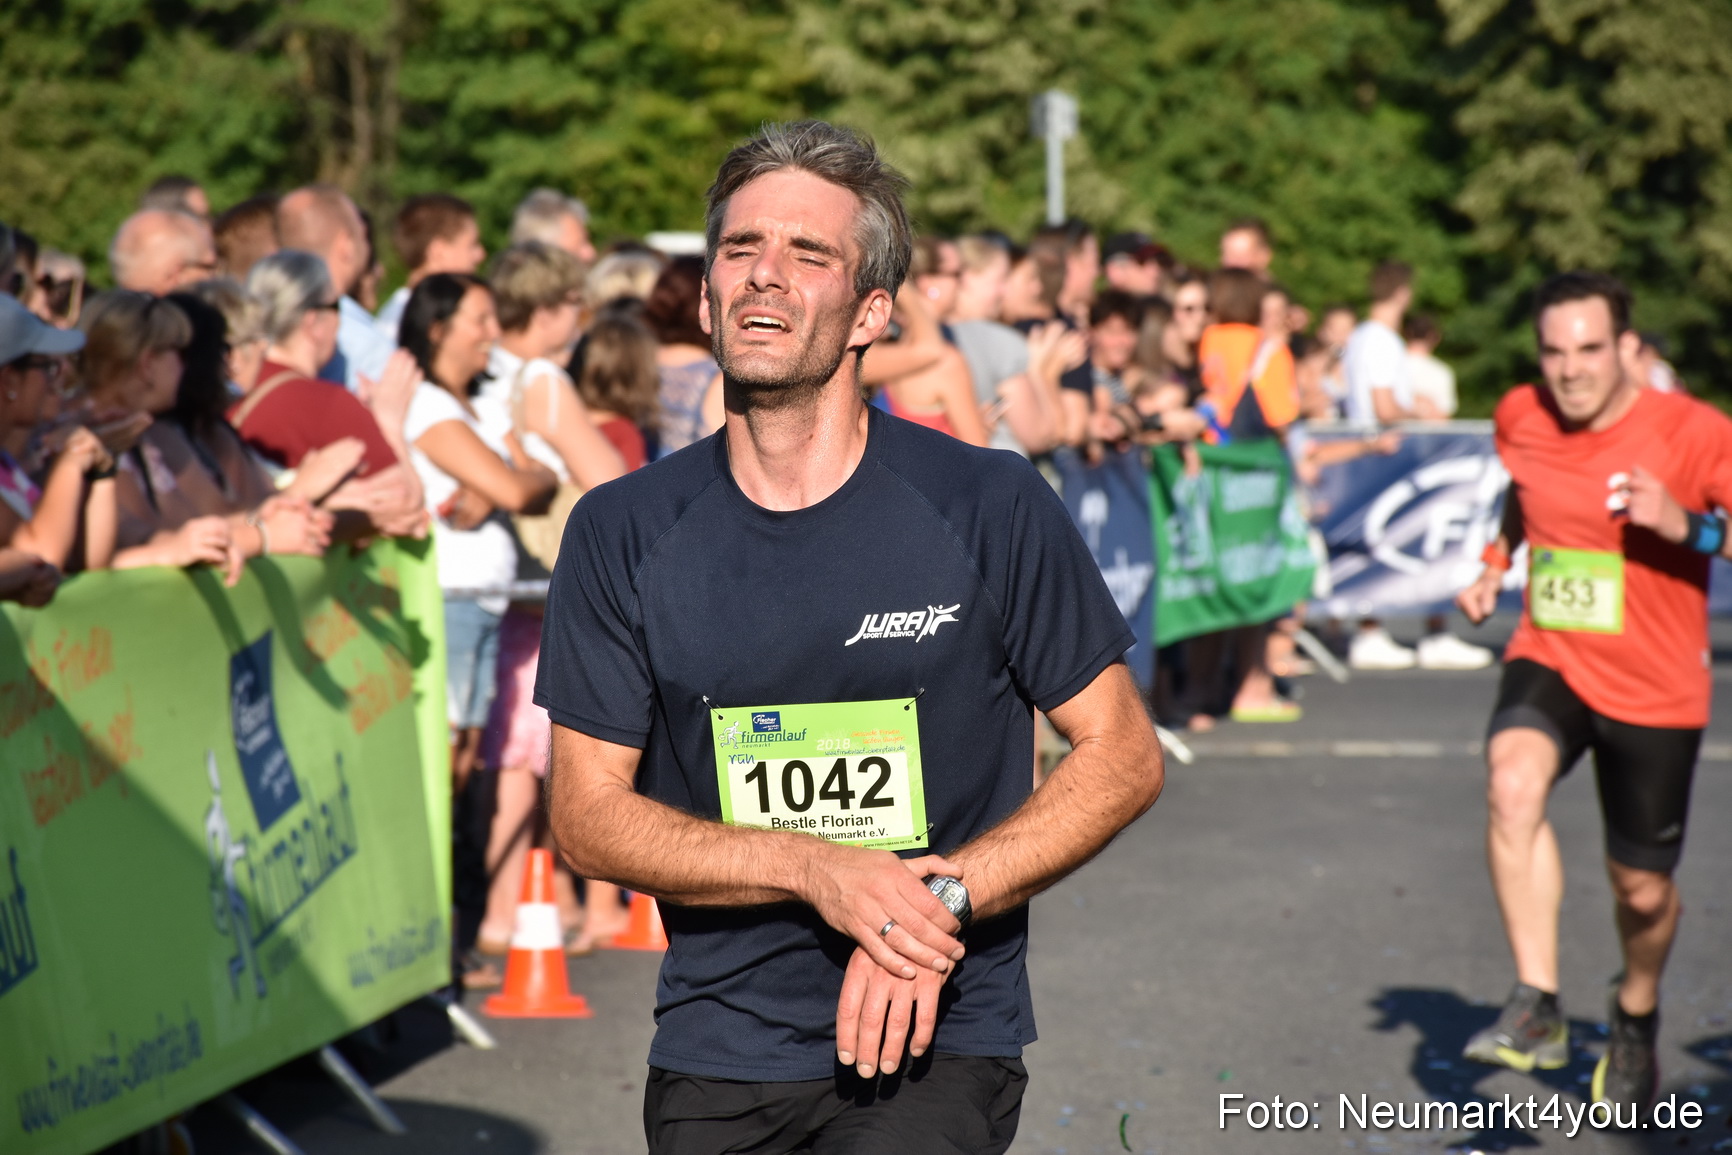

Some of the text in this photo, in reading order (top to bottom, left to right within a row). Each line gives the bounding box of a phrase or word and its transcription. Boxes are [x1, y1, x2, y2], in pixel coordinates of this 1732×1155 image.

[1540, 578, 1596, 608] 453
[844, 611, 927, 646] JURA
[863, 630, 916, 639] SPORT SERVICE
[741, 728, 807, 743] firmenlauf
[816, 738, 851, 751] 2018
[745, 756, 895, 814] 1042
[771, 814, 874, 830] Bestle Florian
[818, 829, 867, 840] Neumarkt
[869, 827, 889, 838] e.V.
